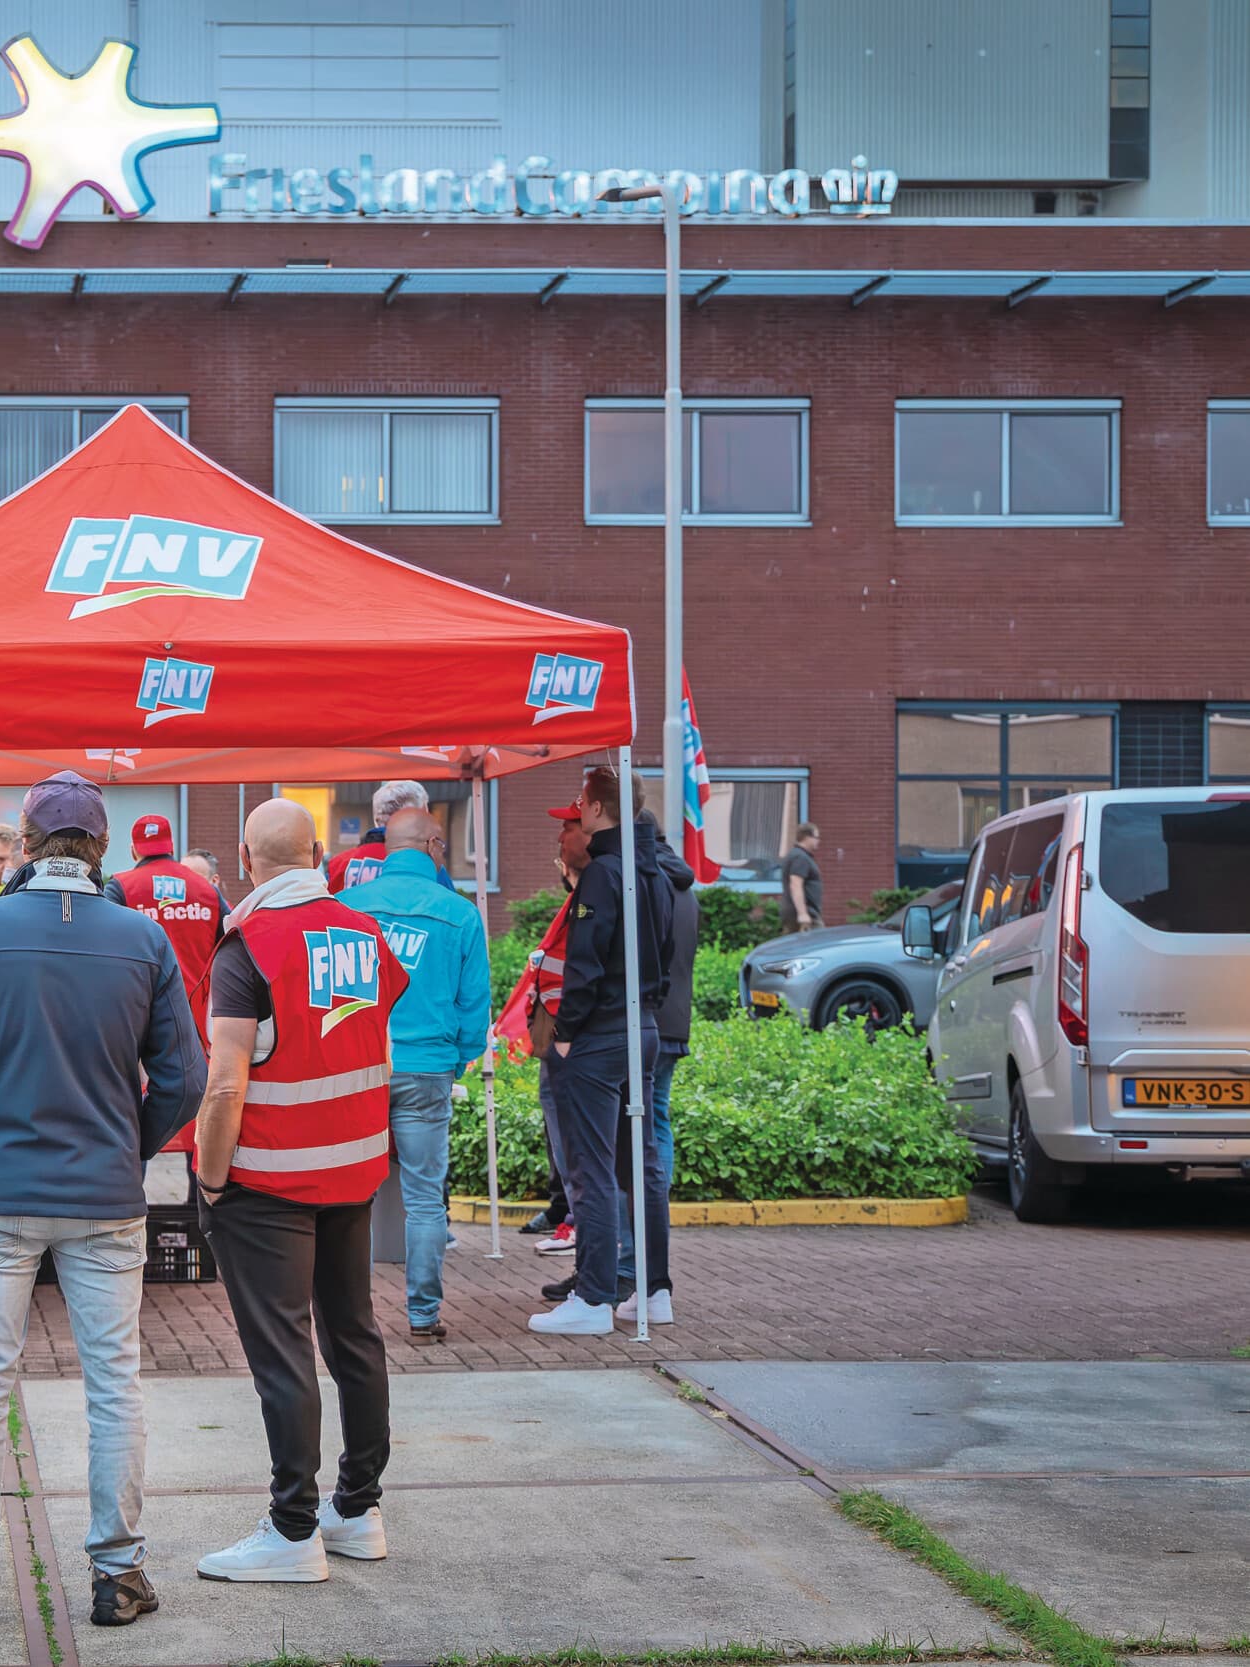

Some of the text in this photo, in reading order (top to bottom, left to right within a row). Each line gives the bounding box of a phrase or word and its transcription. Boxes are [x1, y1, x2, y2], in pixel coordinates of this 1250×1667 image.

[62, 533, 254, 578] FNV
[142, 668, 211, 698] FNV
[532, 666, 600, 696] FNV
[154, 880, 184, 896] FNV
[163, 903, 212, 921] actie
[312, 941, 376, 991] FNV
[1142, 1083, 1244, 1101] VNK-30-S
